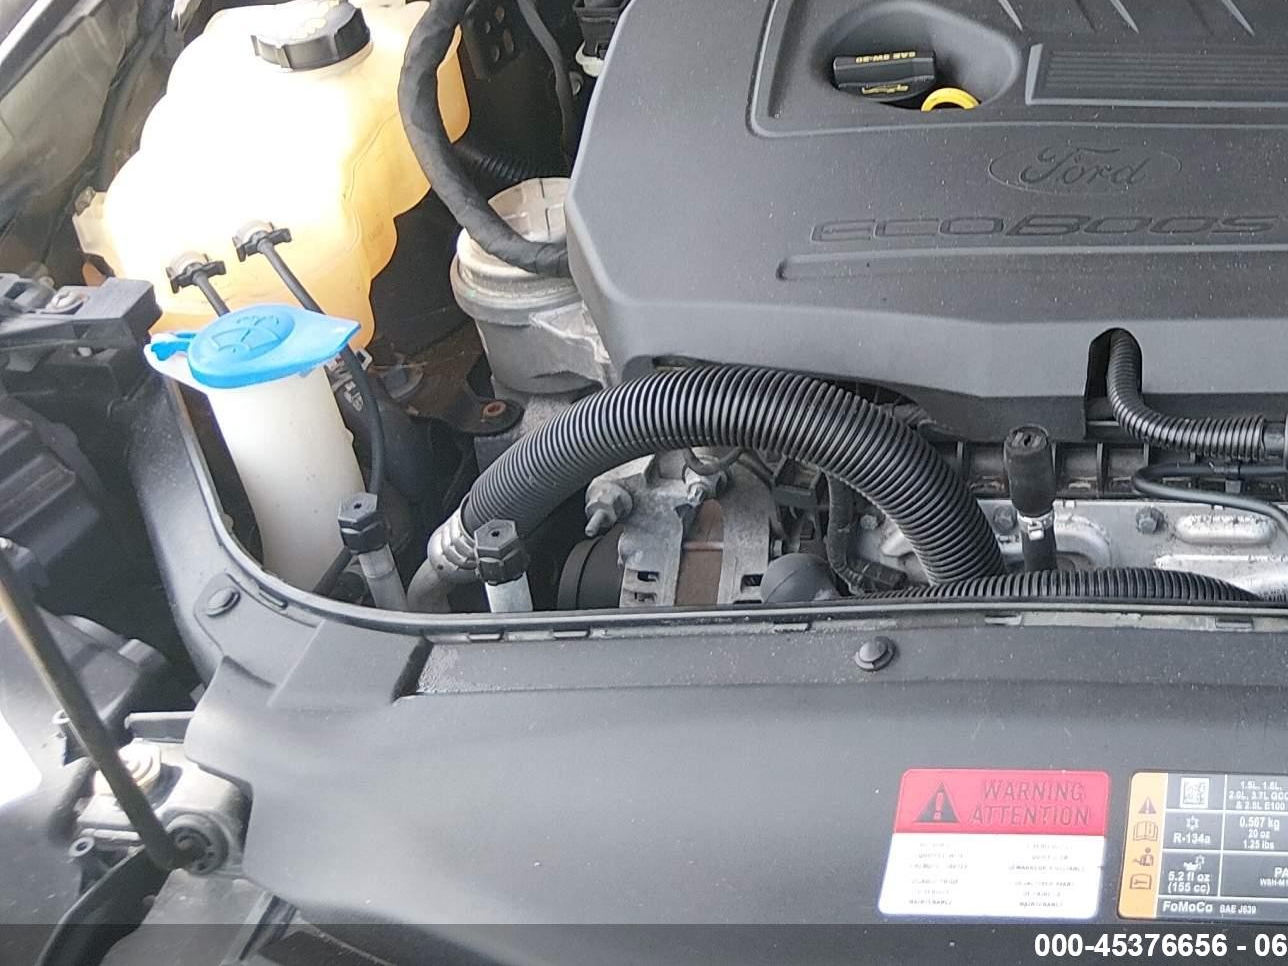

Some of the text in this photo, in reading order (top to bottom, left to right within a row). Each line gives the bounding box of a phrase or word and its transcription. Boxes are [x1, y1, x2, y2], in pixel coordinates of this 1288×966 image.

[1019, 145, 1146, 187] Ford
[982, 780, 1086, 802] WARNING
[970, 804, 1092, 826] ATTENTION
[1268, 817, 1280, 831] kg
[1173, 833, 1211, 844] R-134a
[1248, 829, 1258, 838] 20
[1262, 840, 1275, 850] lbs
[1168, 872, 1210, 882] 5.2 fl oz
[1194, 882, 1210, 894] cc)
[1162, 901, 1213, 913] FoMoCo
